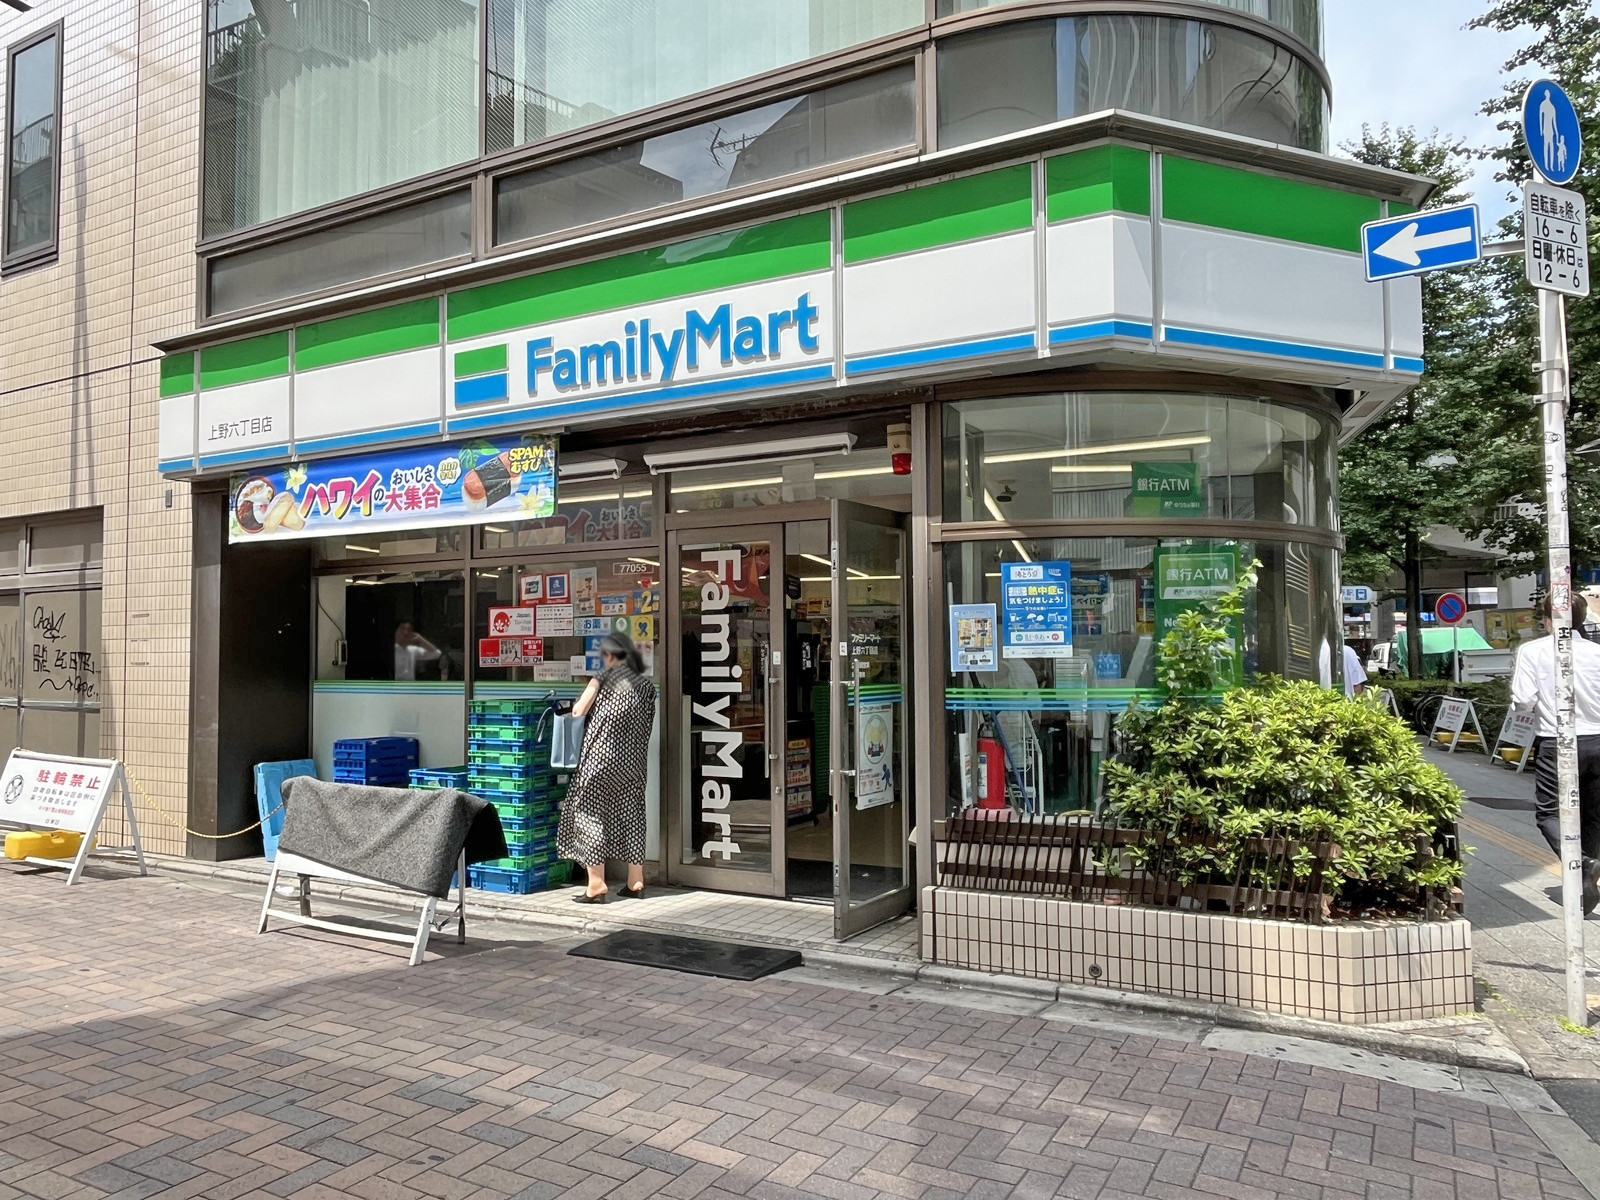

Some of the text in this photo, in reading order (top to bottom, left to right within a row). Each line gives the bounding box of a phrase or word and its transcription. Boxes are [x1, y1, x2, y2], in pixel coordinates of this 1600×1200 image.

[1530, 193, 1580, 222] 自転車を除く
[526, 291, 820, 397] FamilyMart
[208, 416, 273, 441] 上野六丁目店
[508, 444, 544, 461] SPAM
[510, 458, 541, 474] むすび
[392, 467, 434, 486] おいしさ
[1137, 477, 1190, 491] 銀行ATM
[385, 483, 441, 512] 大集合
[620, 564, 647, 573] 77055
[1166, 568, 1229, 582] 銀行ATM
[851, 633, 881, 643] ファミリーマート
[693, 549, 743, 860] FamilyMart
[36, 769, 101, 790] 駐輪禁止
